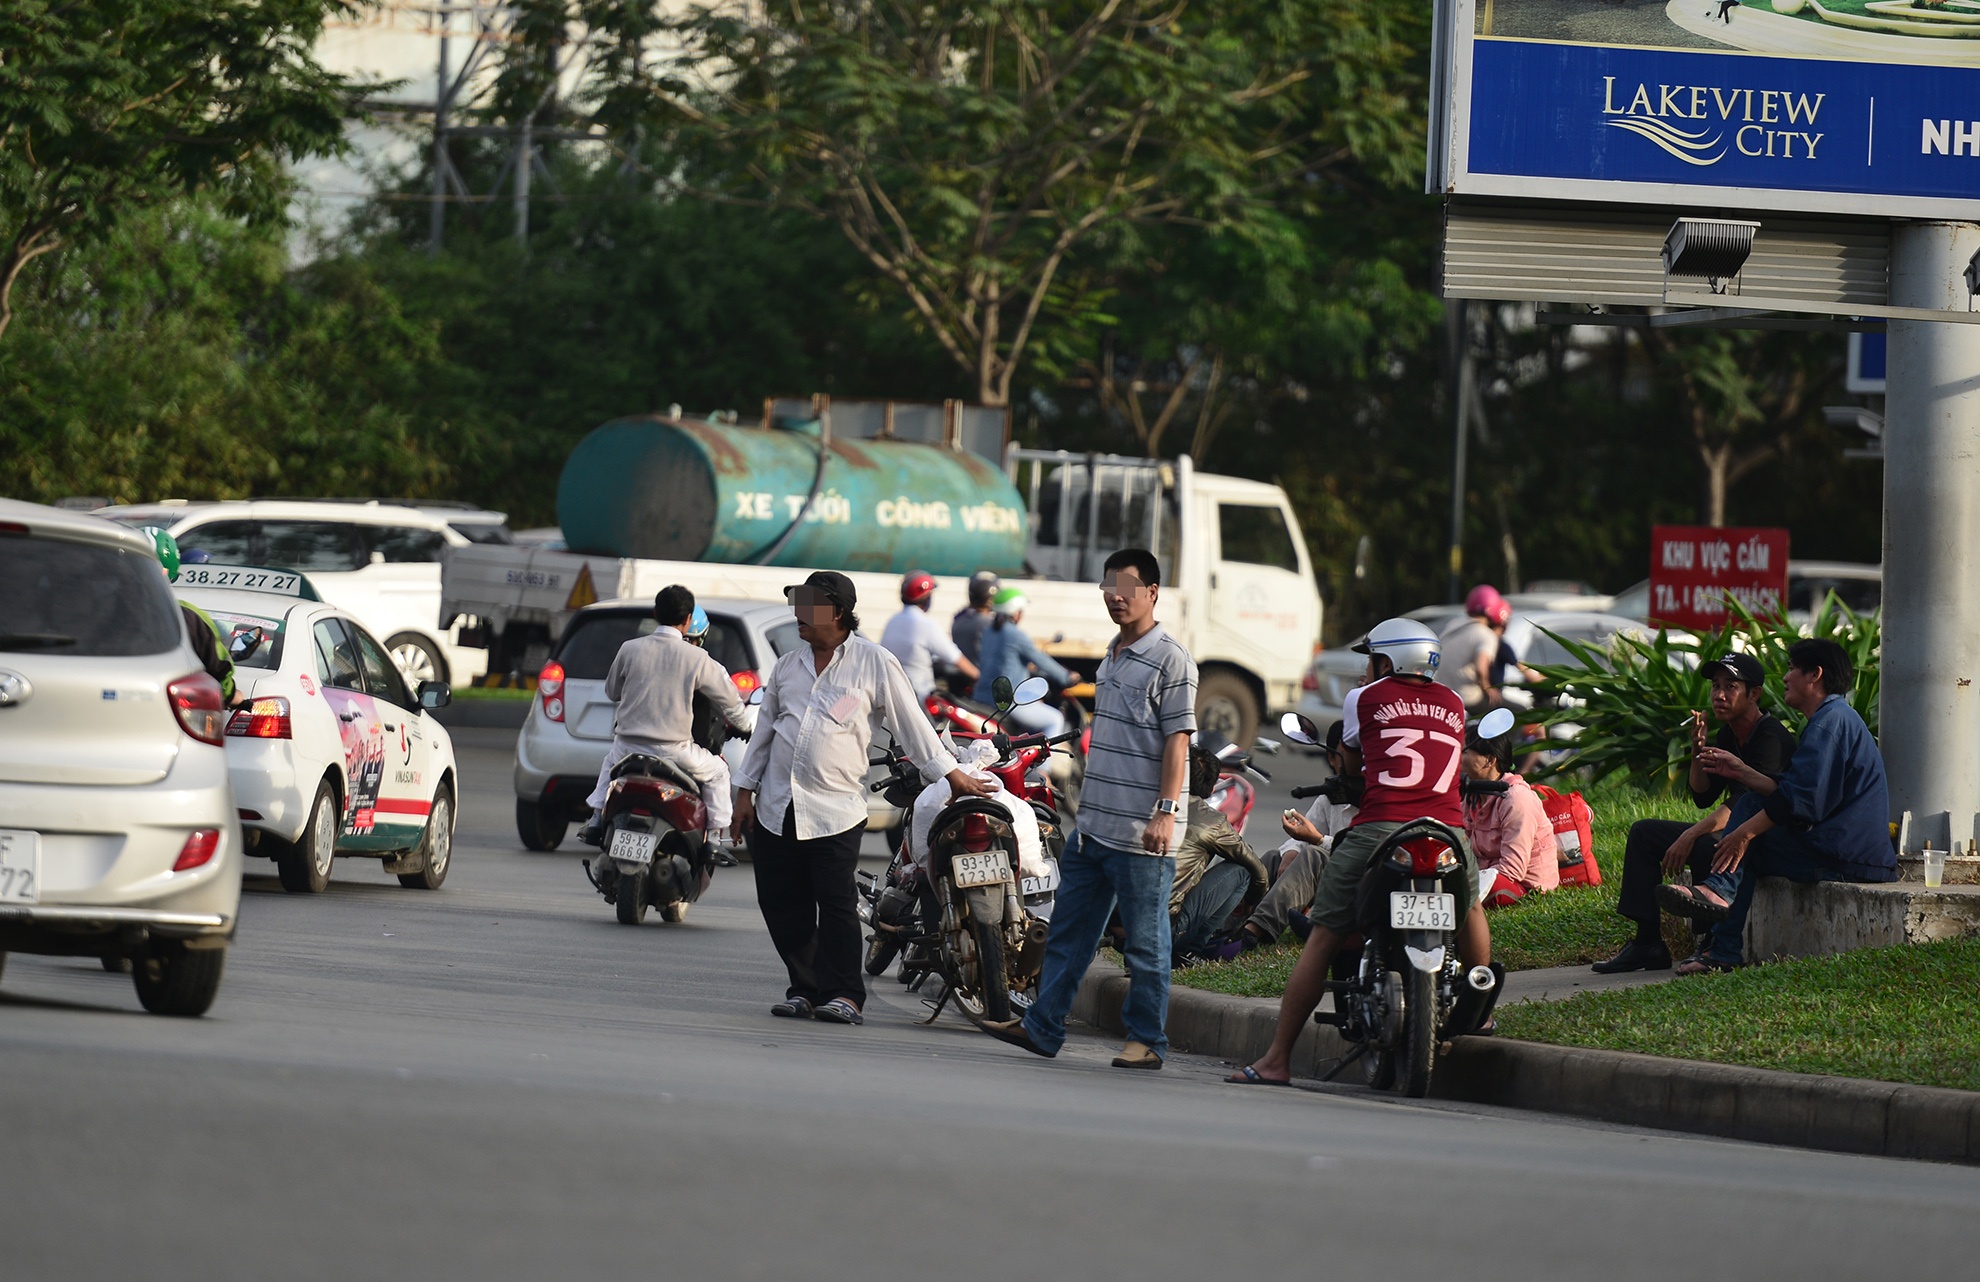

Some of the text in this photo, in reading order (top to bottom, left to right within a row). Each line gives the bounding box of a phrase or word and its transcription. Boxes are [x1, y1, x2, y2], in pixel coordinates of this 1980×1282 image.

[1602, 76, 1826, 126] LAKEVIEW
[1736, 125, 1825, 159] CITY
[735, 491, 774, 520] XE
[876, 496, 951, 528] CÔNG
[1662, 540, 1695, 570] KHU
[1700, 537, 1731, 577] VỰC
[185, 569, 297, 590] 38.27 27 27
[1429, 704, 1447, 721] VEN
[1378, 728, 1461, 794] 37
[619, 832, 649, 848] 59-X2
[612, 844, 649, 860] 866.94
[961, 853, 1000, 871] 93-P1
[959, 867, 1008, 885] 123.18
[1401, 895, 1443, 911] 37-E1
[1396, 911, 1450, 927] 324.82
